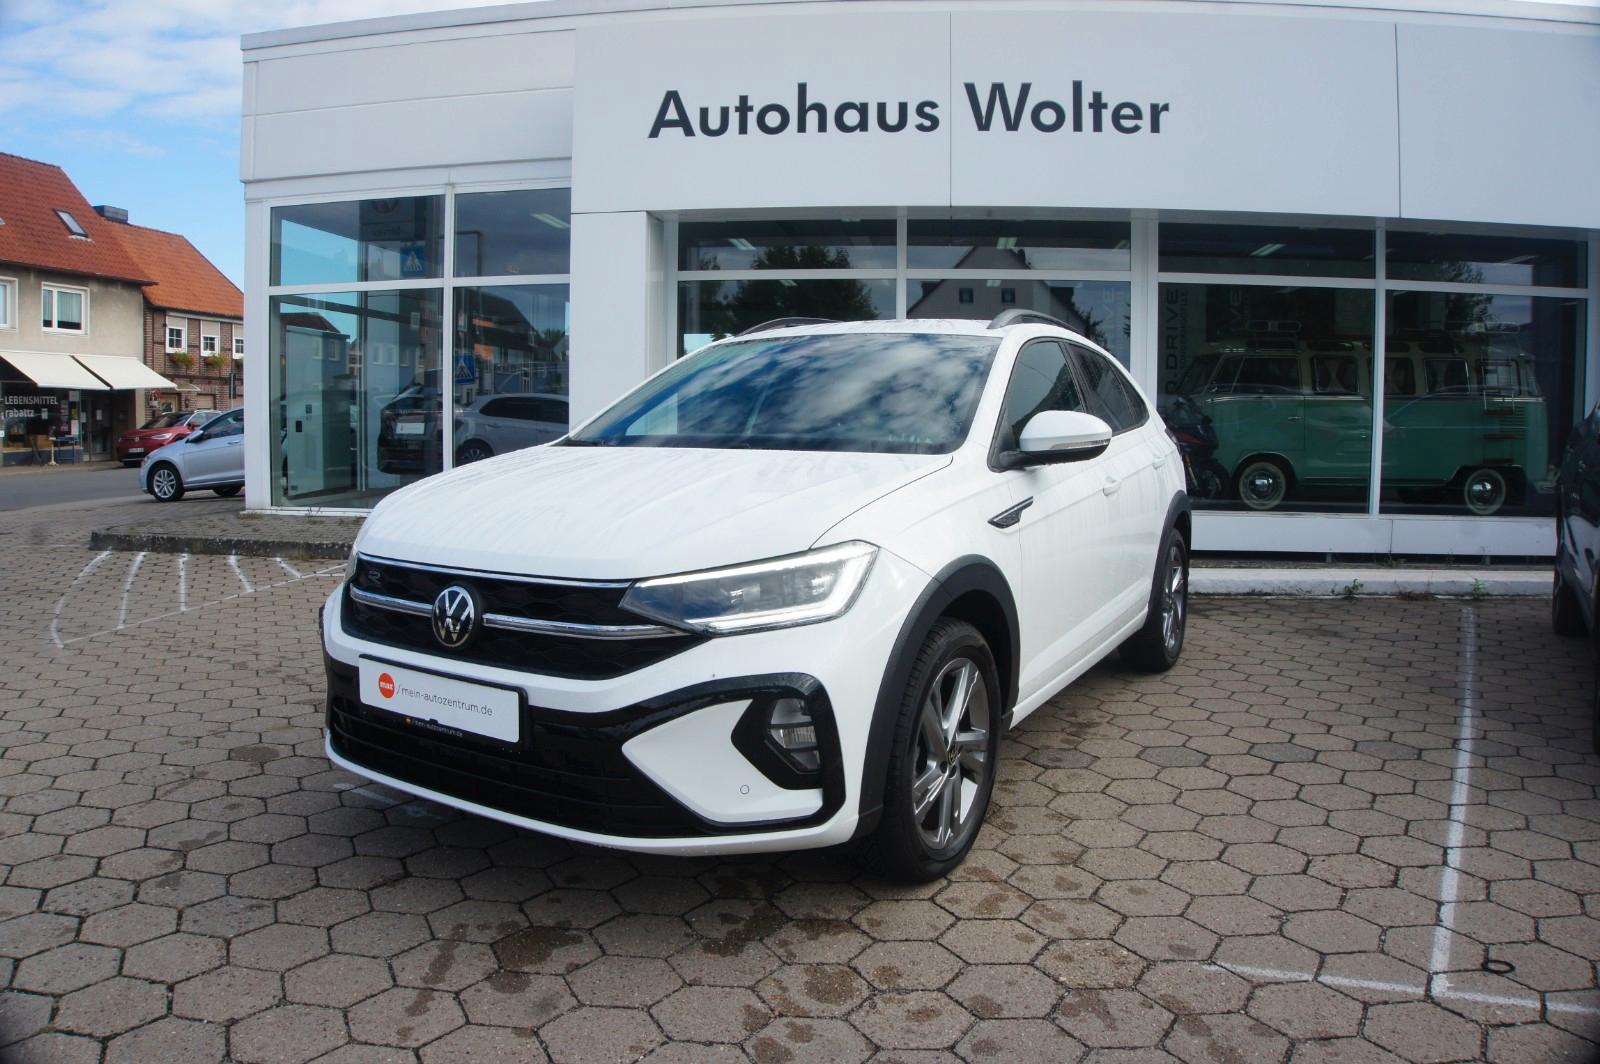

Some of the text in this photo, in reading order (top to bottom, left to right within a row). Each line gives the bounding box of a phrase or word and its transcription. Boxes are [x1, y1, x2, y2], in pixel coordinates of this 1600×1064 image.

[648, 80, 1171, 139] Autohaus Wolter
[4, 395, 58, 405] LEBENSMITTEL
